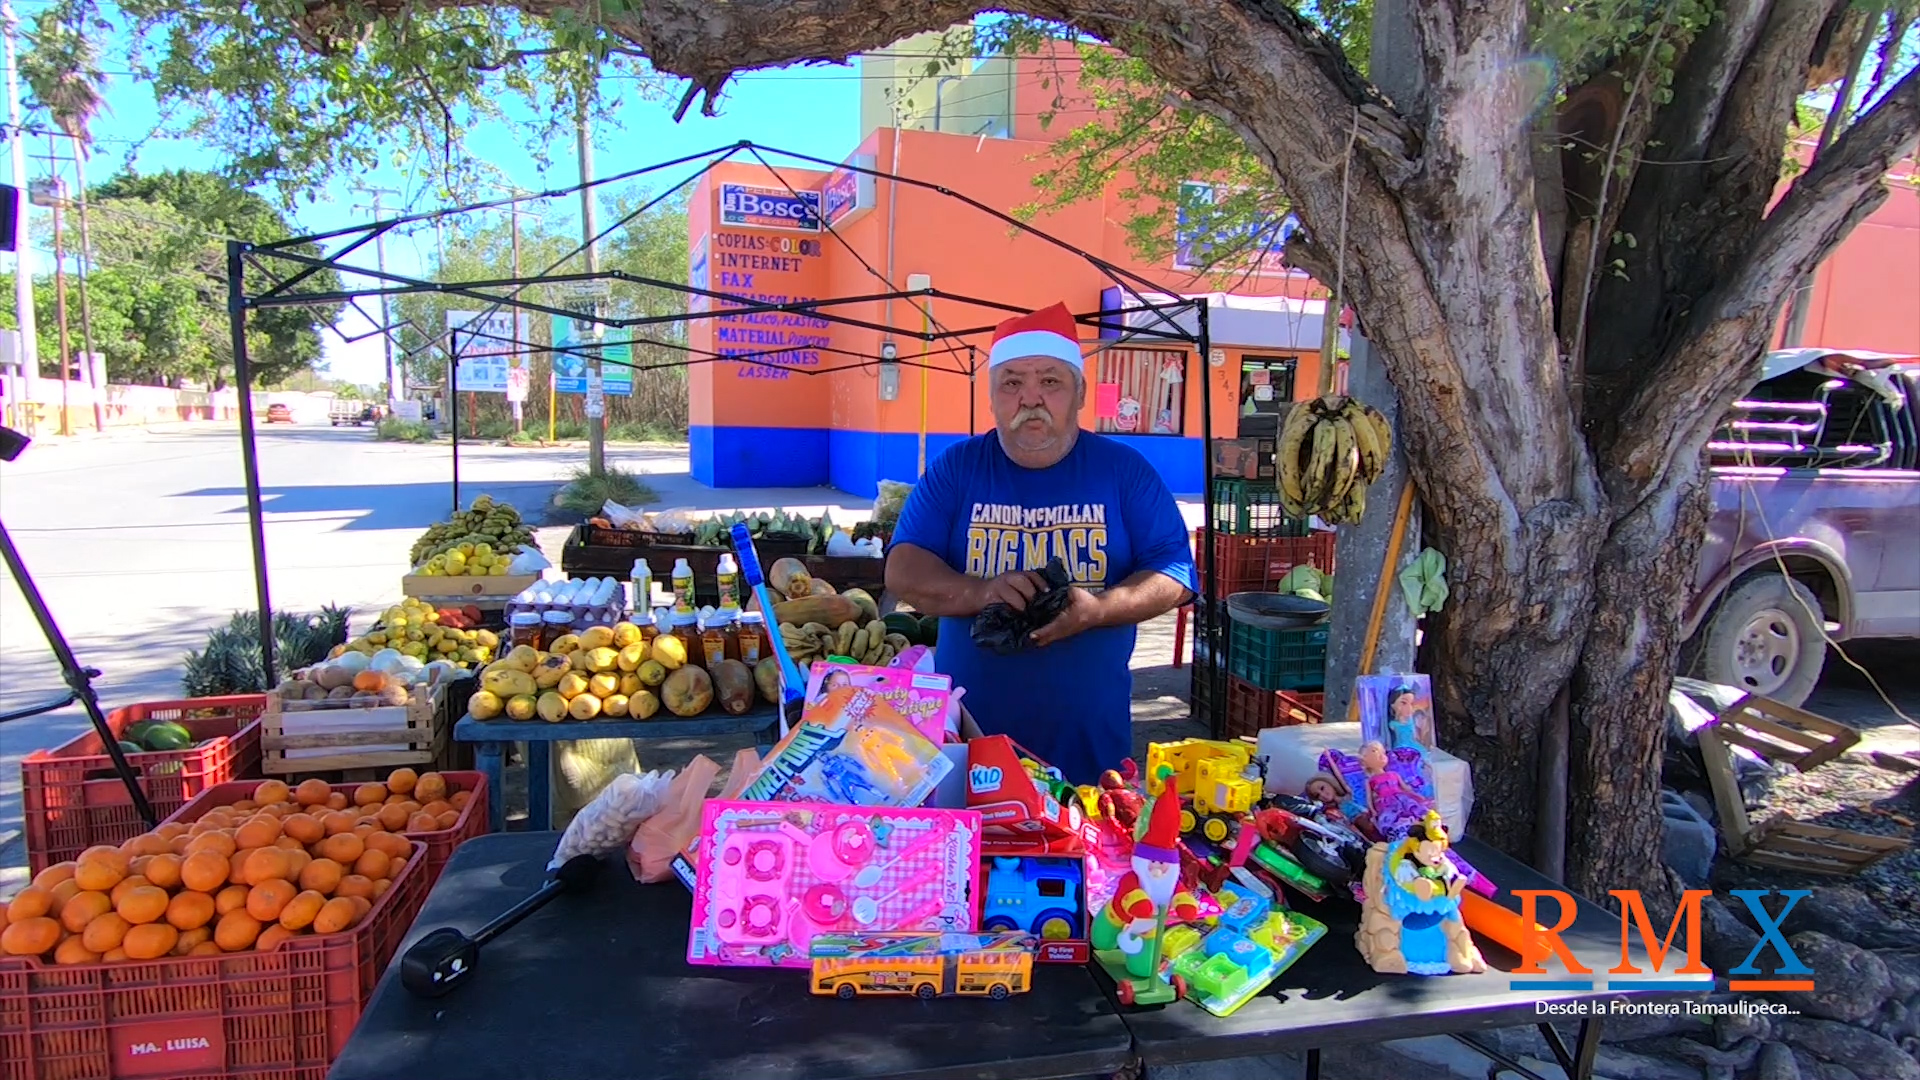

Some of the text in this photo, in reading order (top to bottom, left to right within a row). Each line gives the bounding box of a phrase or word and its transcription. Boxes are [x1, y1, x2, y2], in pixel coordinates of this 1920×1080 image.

[769, 237, 822, 257] COLOR
[720, 252, 803, 272] INTERNET
[721, 271, 754, 288] FAX
[718, 327, 785, 345] MATERIAL
[964, 528, 1107, 582] BIG MACS
[971, 767, 1000, 786] KID
[944, 834, 959, 902] Kitchen Set
[130, 1037, 210, 1055] MA. LUISA
